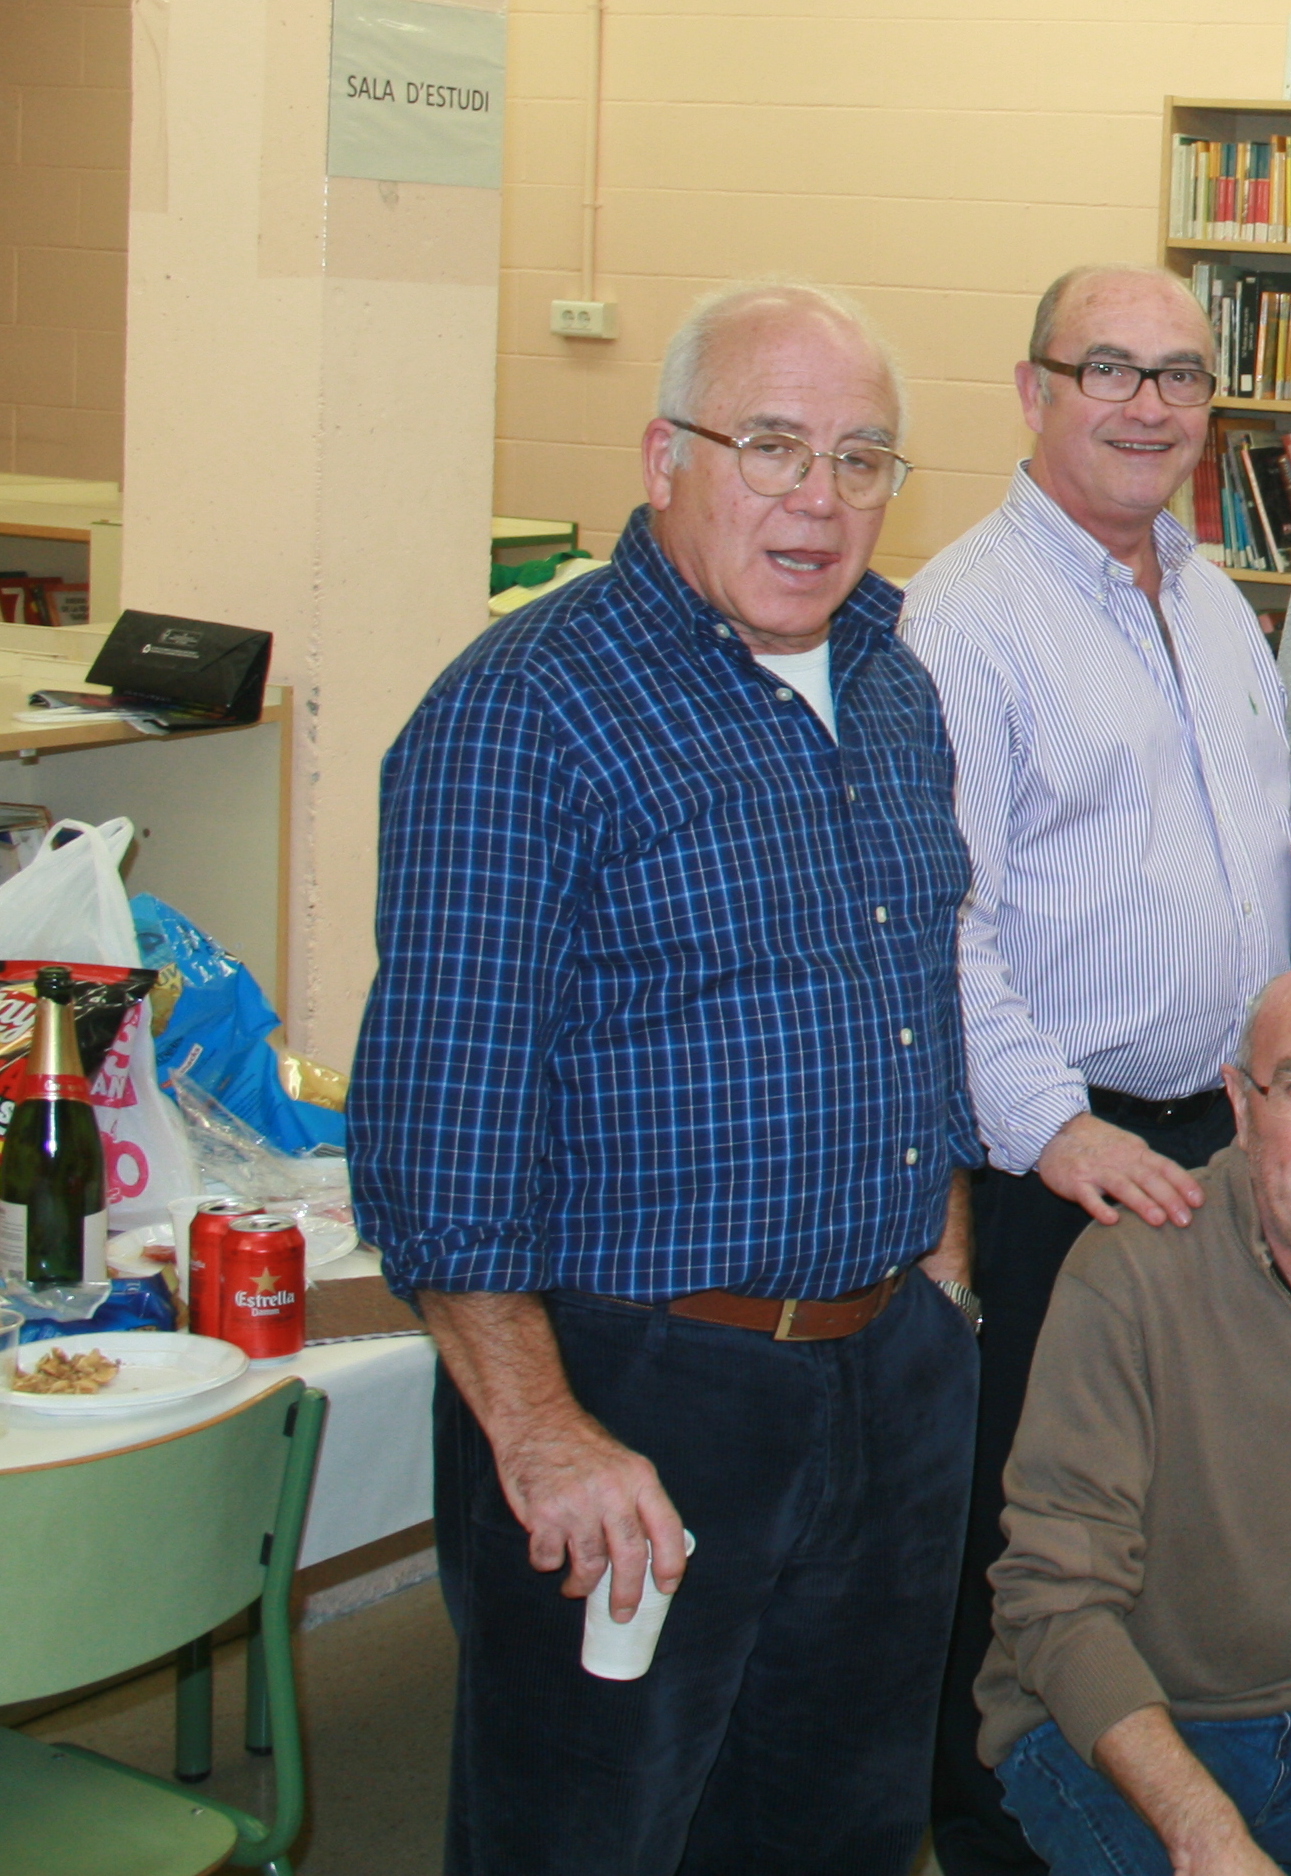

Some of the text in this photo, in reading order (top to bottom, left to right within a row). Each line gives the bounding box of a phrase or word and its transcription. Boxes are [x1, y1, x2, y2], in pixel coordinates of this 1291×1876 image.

[347, 75, 490, 112] SALA D'ESTUDI
[235, 1290, 295, 1308] Estrella
